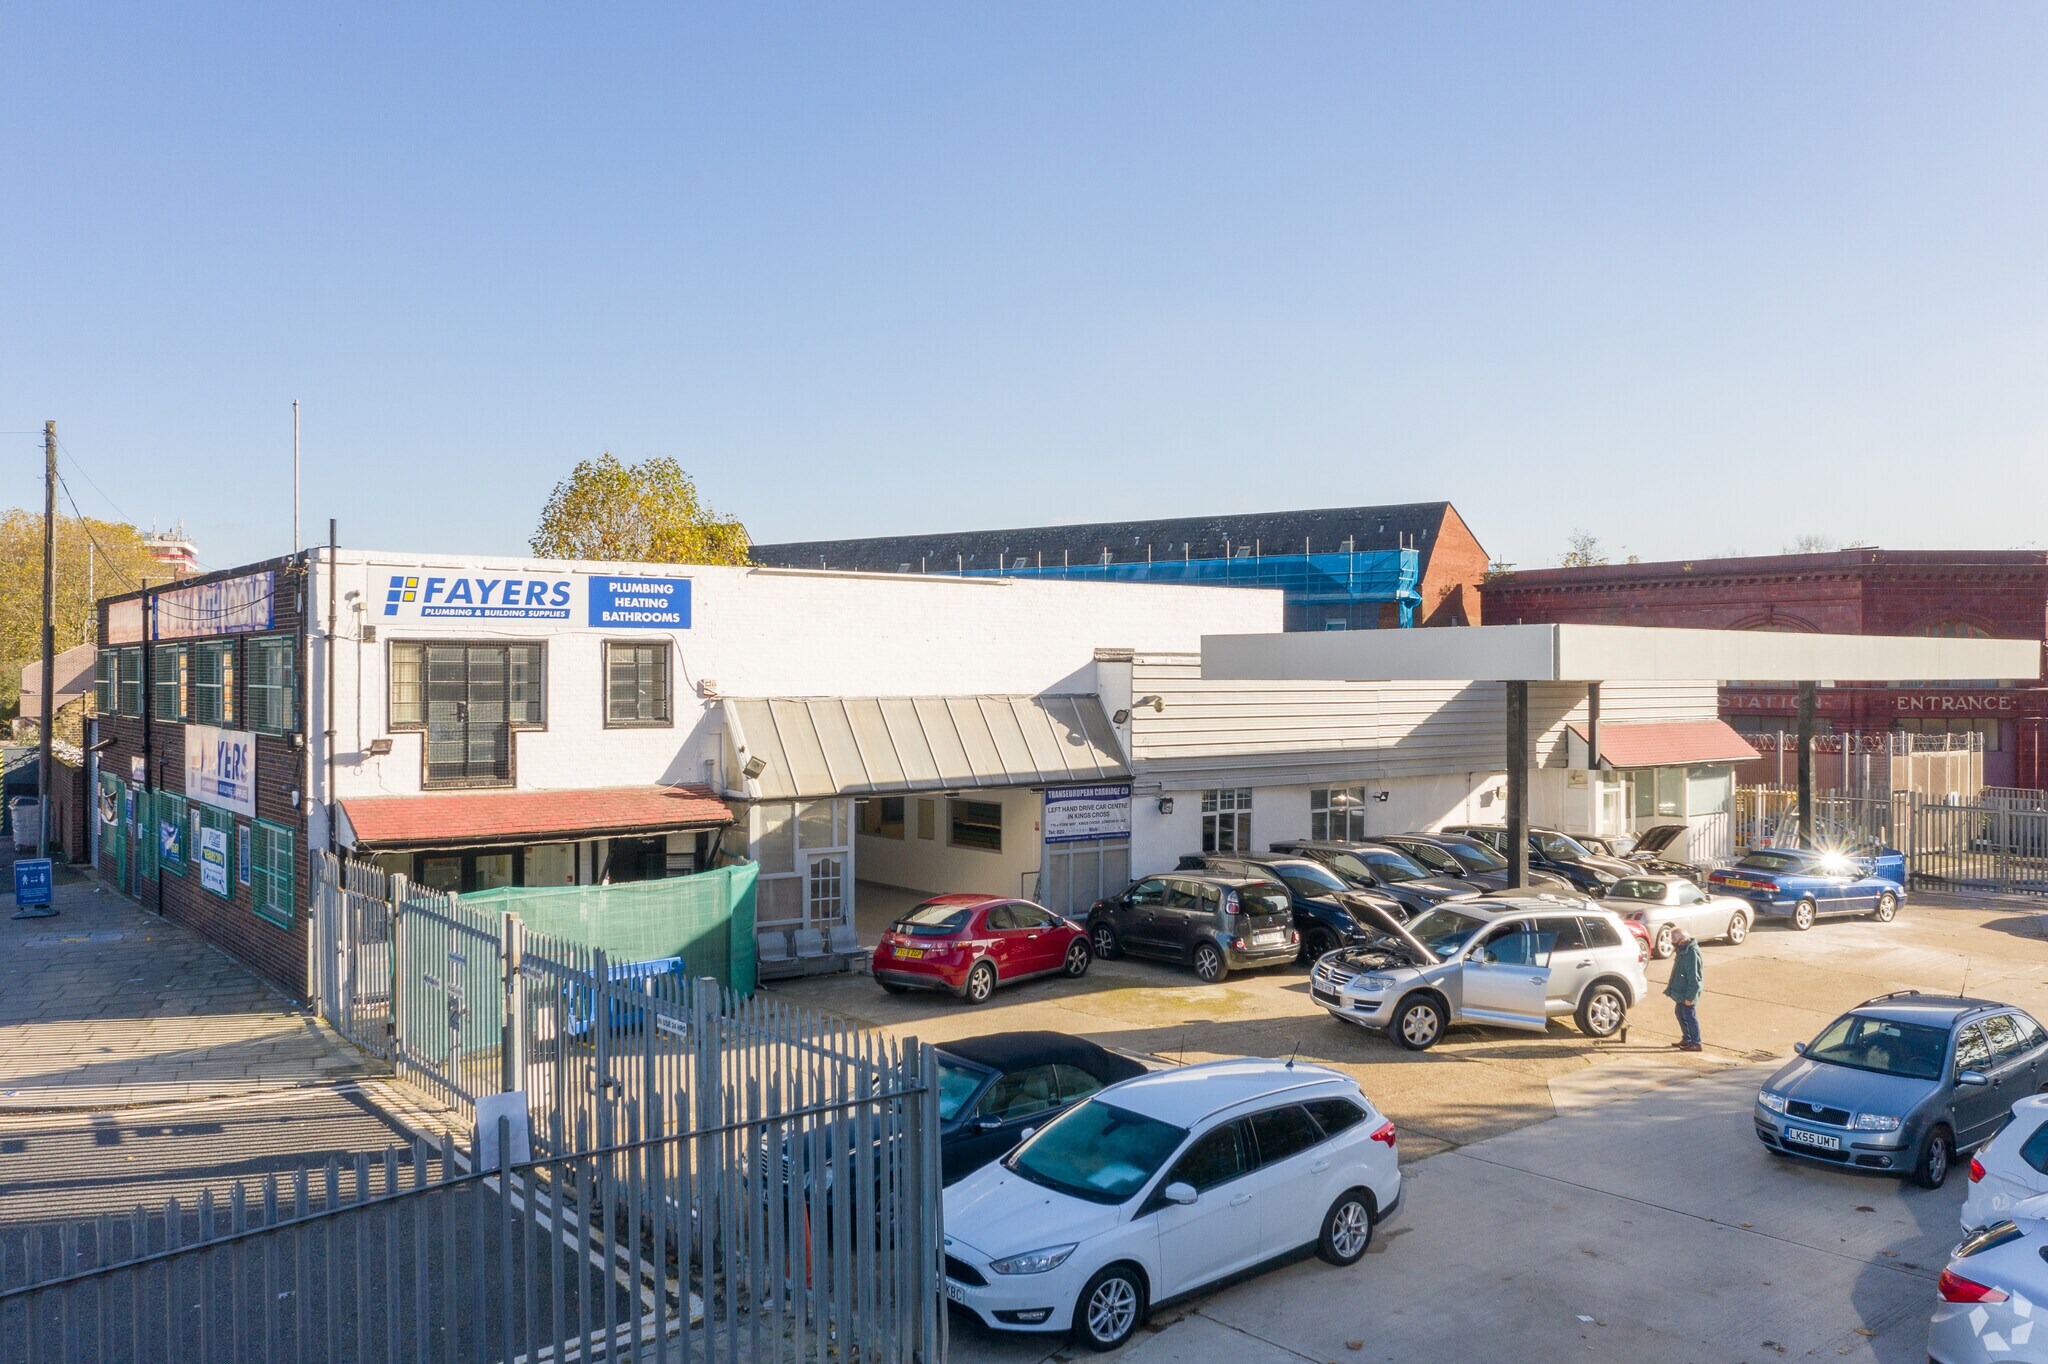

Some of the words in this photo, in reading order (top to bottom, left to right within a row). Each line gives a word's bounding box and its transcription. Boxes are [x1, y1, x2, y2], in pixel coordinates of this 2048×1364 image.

[422, 577, 572, 607] FAYERS
[608, 582, 675, 595] PLUMBING
[614, 597, 669, 609] HEATING
[424, 607, 473, 617] PLUMBING
[474, 609, 482, 617] &
[484, 609, 526, 618] BUILDING
[528, 609, 567, 619] SUPPLIES
[602, 610, 681, 624] BATHROOMS
[1897, 695, 2012, 711] ENTRANCE
[1048, 788, 1093, 798] TRANSEUROPEAN
[1094, 787, 1121, 796] CARRIAGE
[1047, 806, 1061, 814] LEFT
[1107, 802, 1128, 810] CENTRE
[1091, 811, 1111, 819] CROSS
[1789, 1129, 1815, 1144] LK55
[1817, 1135, 1837, 1148] UMT
